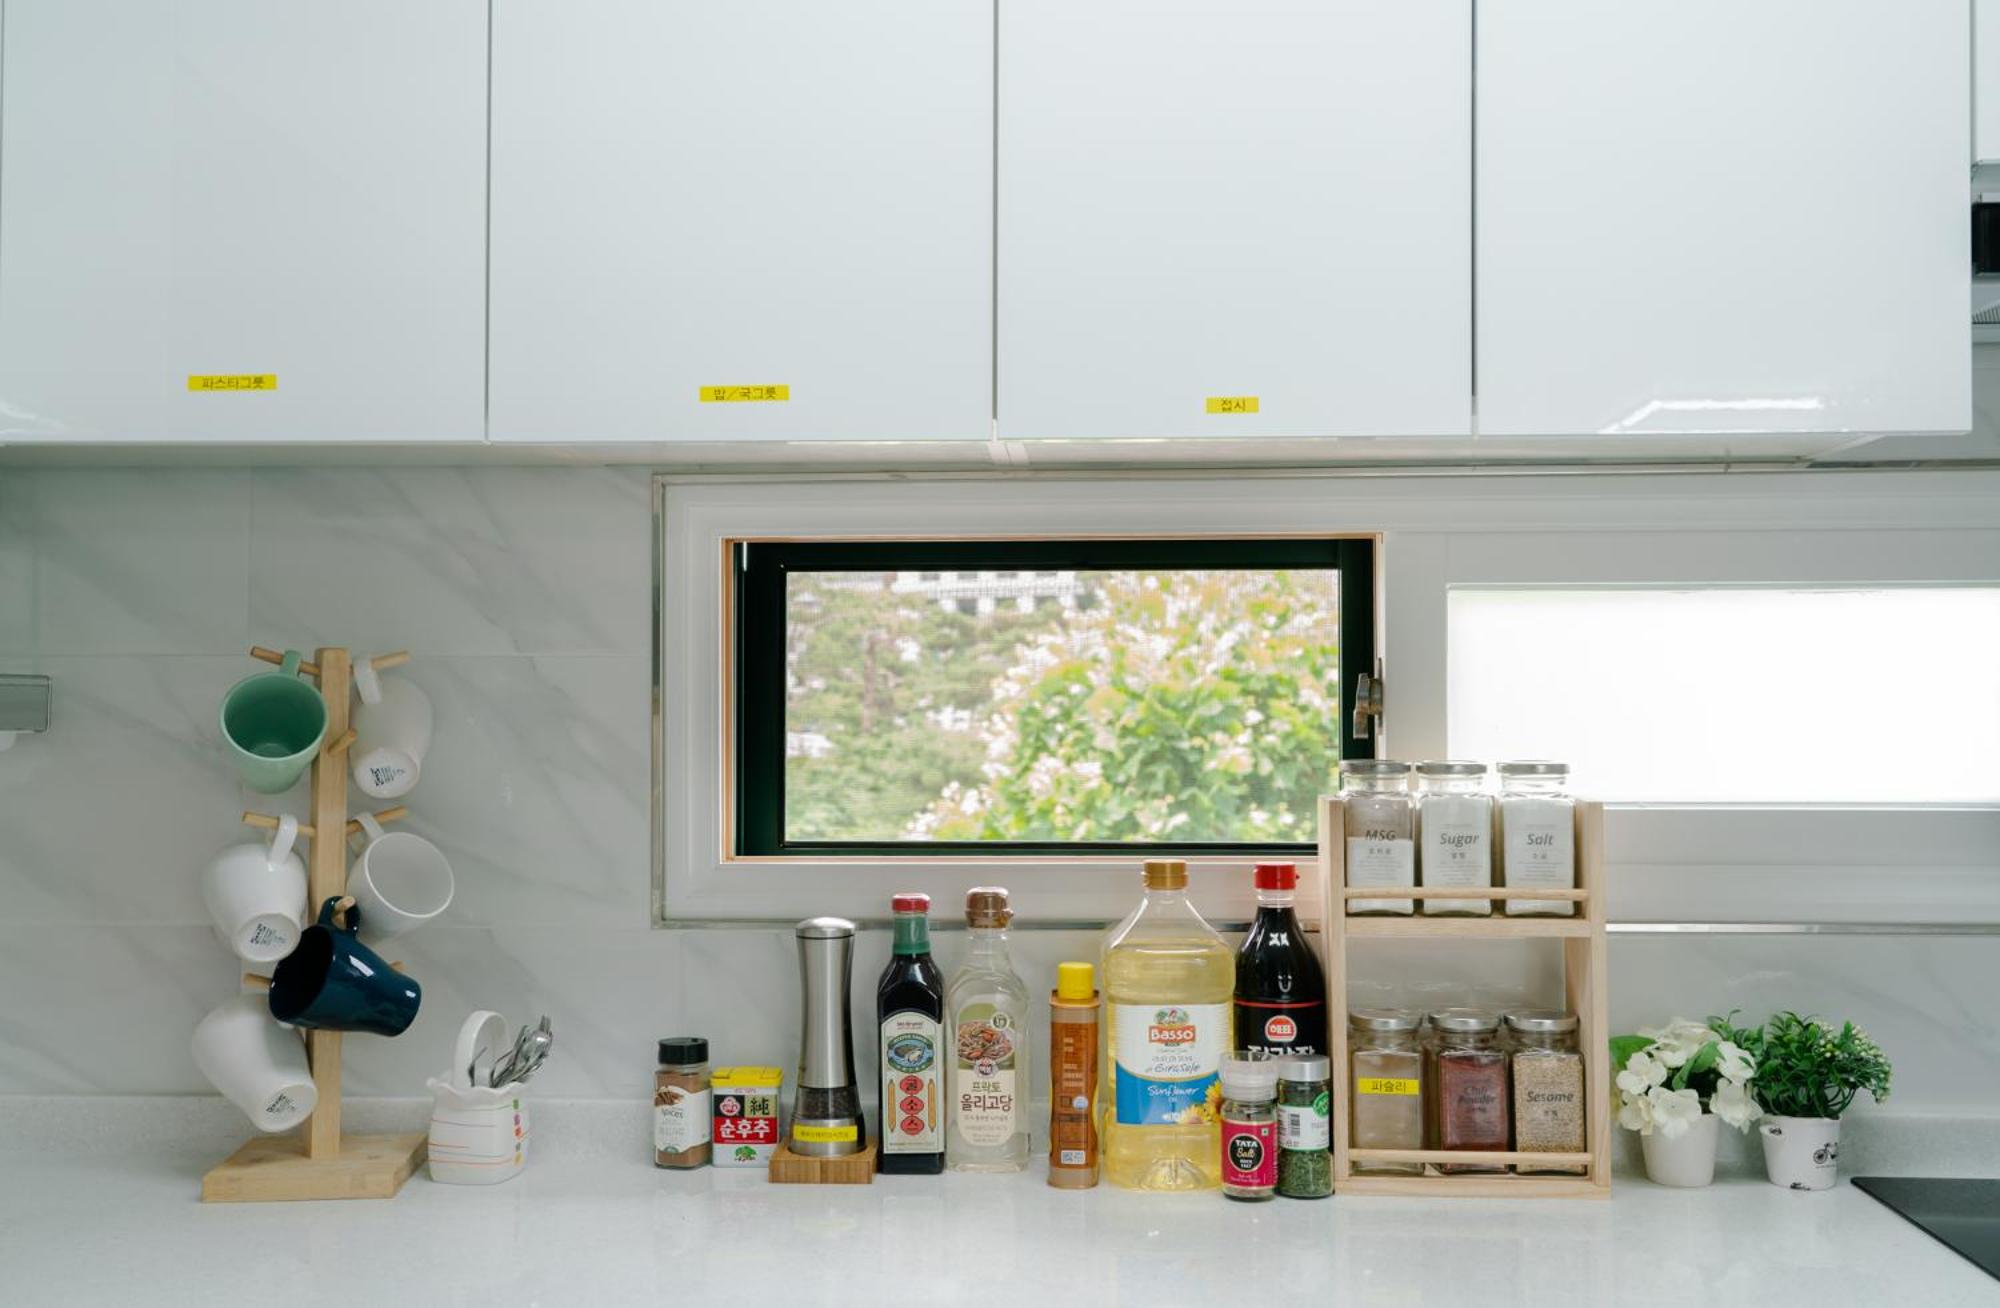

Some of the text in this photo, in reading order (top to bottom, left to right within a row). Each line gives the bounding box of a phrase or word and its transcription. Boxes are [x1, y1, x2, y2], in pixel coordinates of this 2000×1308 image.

[202, 377, 265, 391] 파스타그릇
[1221, 399, 1246, 412] 접시
[1365, 829, 1397, 841] MSG
[1439, 832, 1480, 849] Sugar
[1526, 833, 1555, 847] Salt
[1150, 1029, 1194, 1040] Basso
[1371, 1080, 1407, 1093] 파슬리
[960, 1094, 1013, 1112] 올리고당
[1526, 1090, 1575, 1103] Sesame
[719, 1119, 771, 1139] 순후추
[1235, 1140, 1258, 1148] TATA
